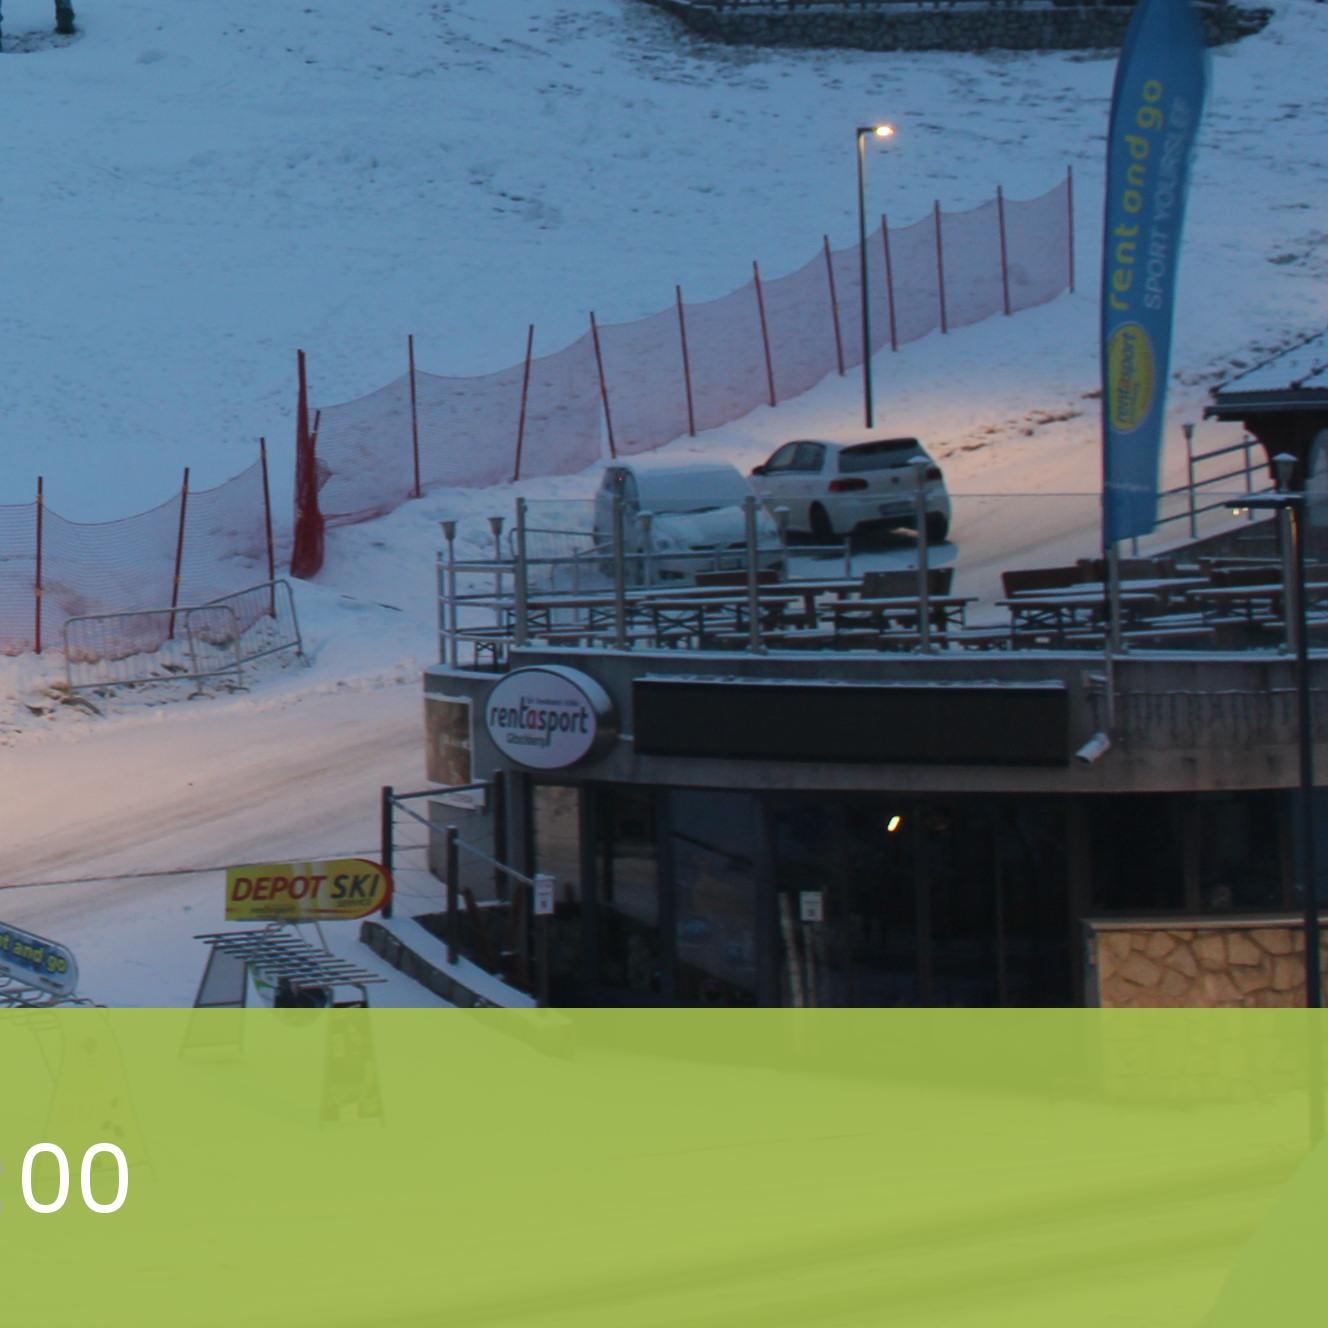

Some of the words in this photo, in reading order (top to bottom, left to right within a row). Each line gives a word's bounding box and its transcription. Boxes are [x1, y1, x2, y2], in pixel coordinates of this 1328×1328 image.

[1134, 79, 1165, 133] go
[1122, 133, 1151, 214] and
[1109, 224, 1140, 311] rent
[490, 695, 590, 747] rentasport
[231, 875, 327, 902] DEPOT
[329, 873, 380, 900] SKI
[12, 941, 45, 964] and
[46, 954, 69, 975] go
